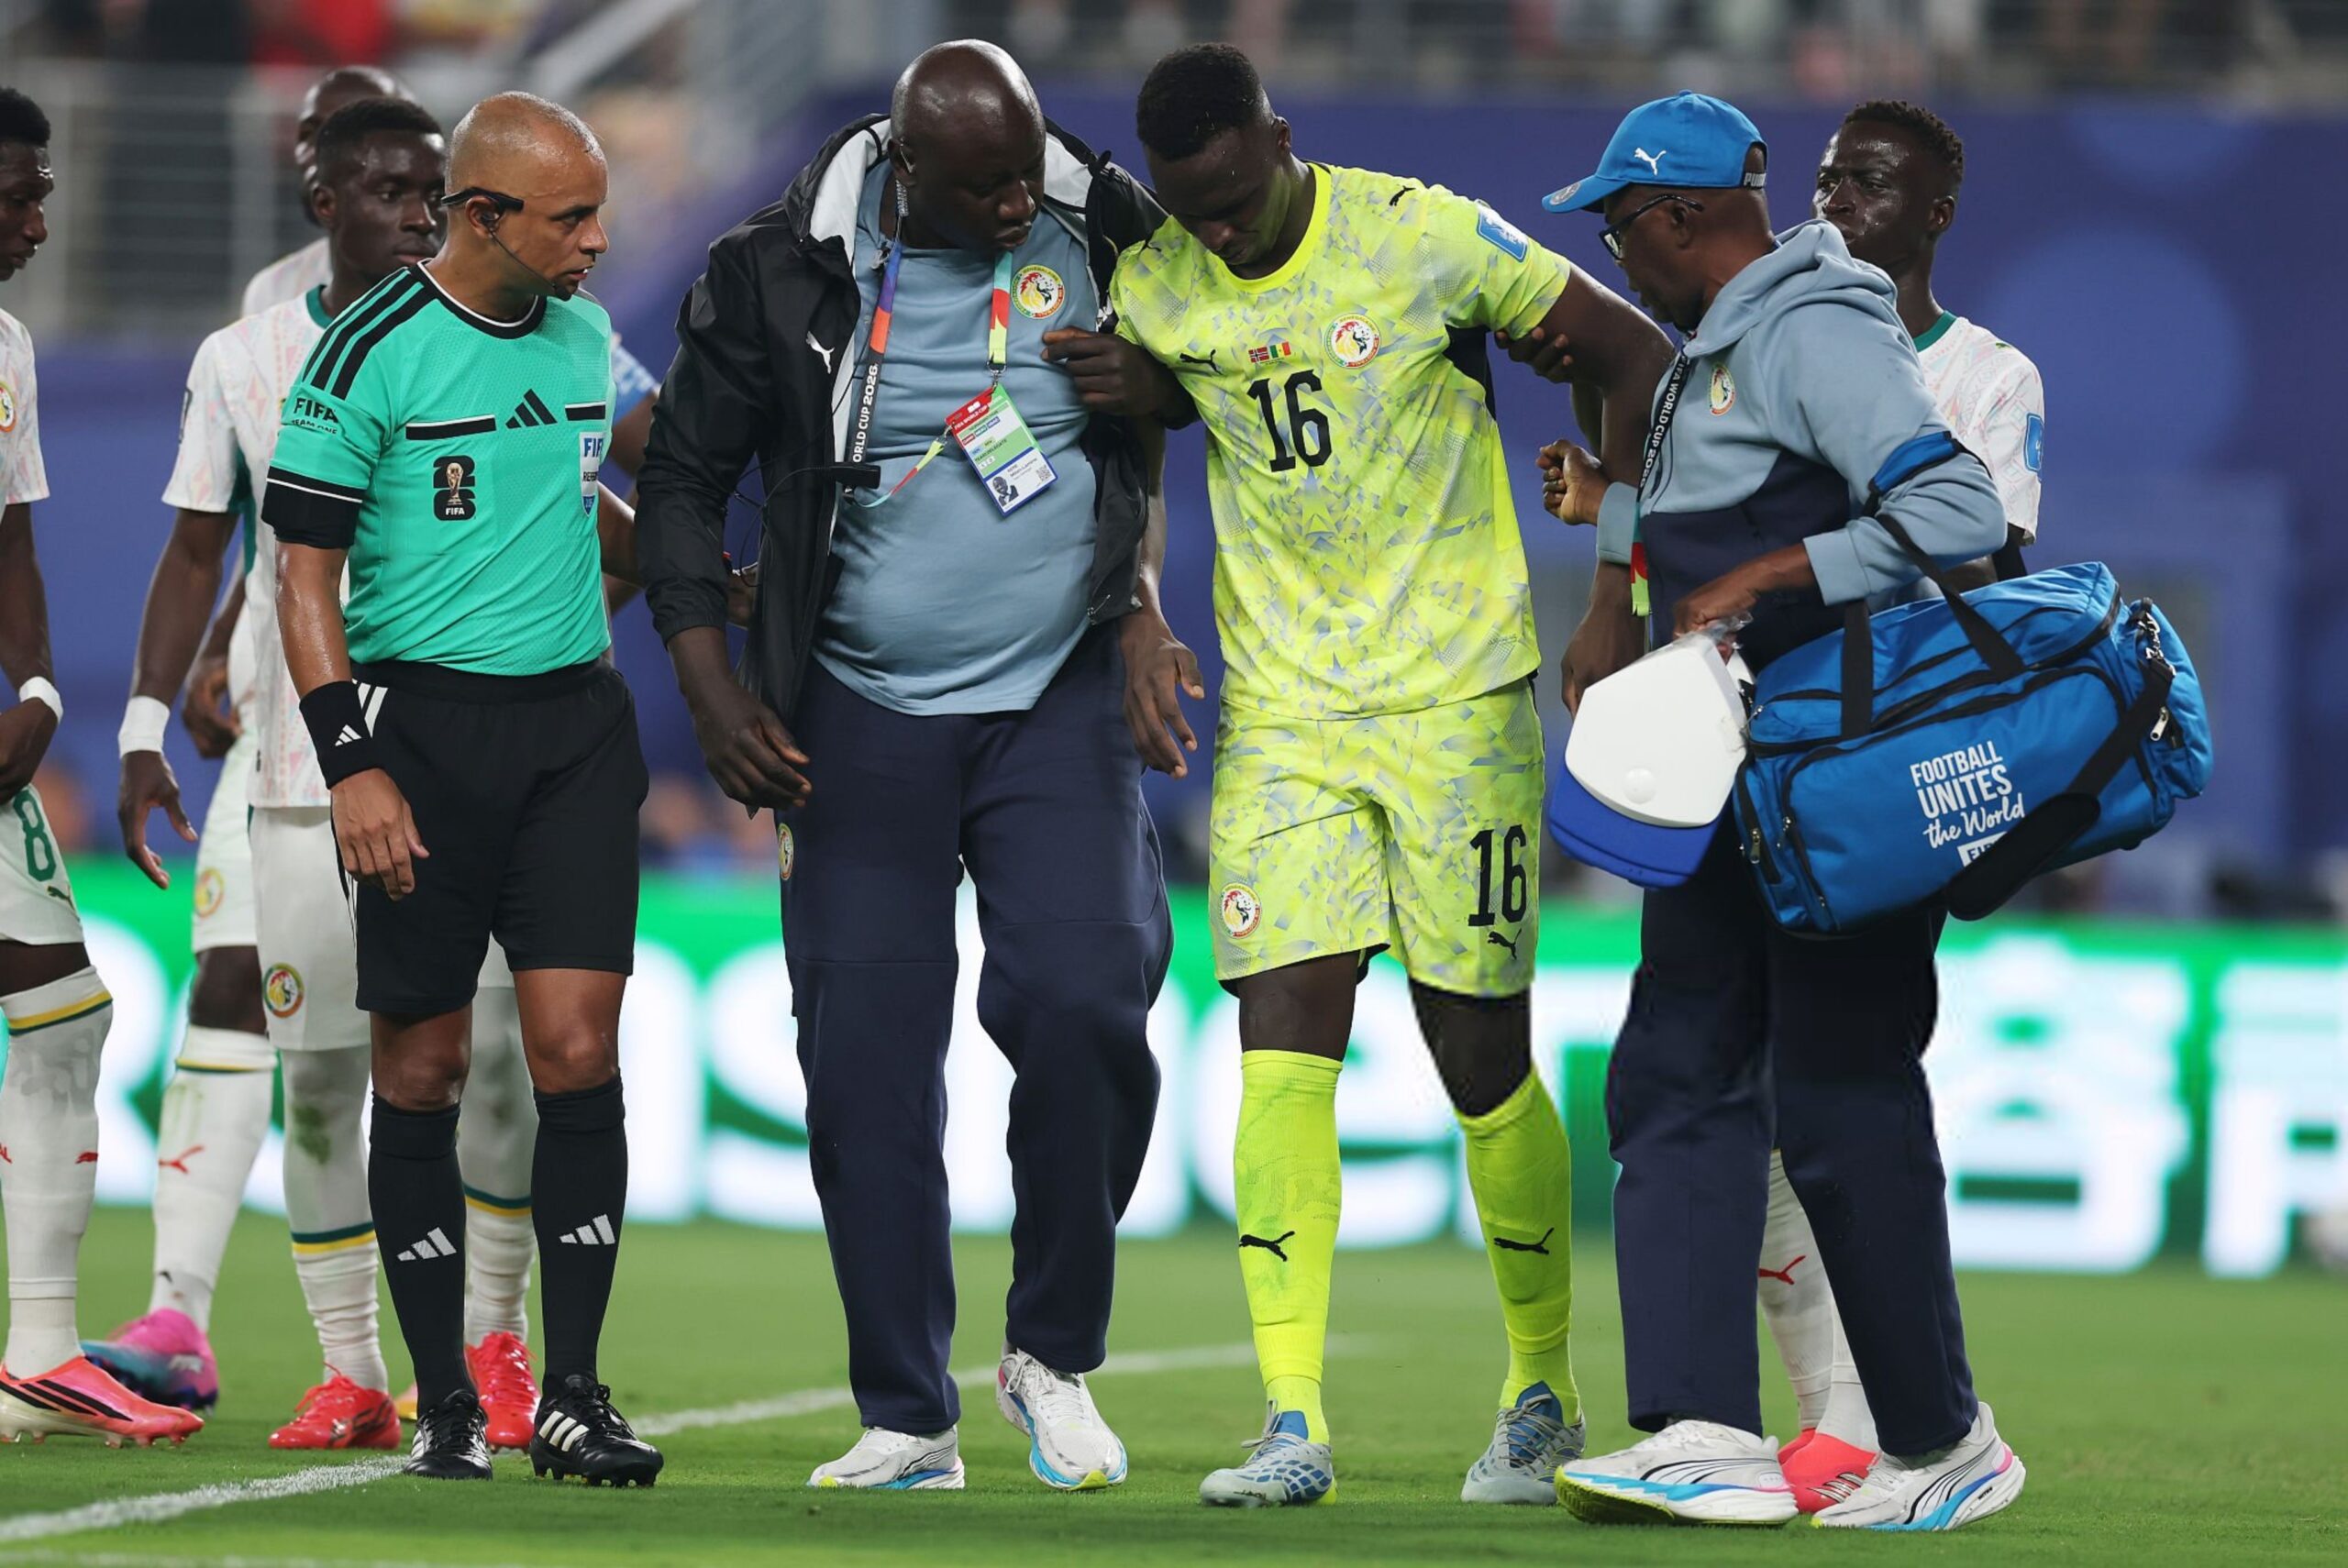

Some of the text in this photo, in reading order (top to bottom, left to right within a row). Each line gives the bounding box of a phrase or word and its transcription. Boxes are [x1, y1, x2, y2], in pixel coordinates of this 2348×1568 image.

[1744, 172, 1767, 186] PUM
[294, 397, 338, 424] FIFA
[852, 365, 879, 463] ORLD CUP 2026
[1246, 369, 1333, 472] 16
[1658, 382, 1679, 424] WORLD
[583, 438, 604, 458] FIF
[1651, 425, 1665, 447] CUP
[445, 507, 465, 515] FIFA
[1910, 740, 2003, 787] FOOTBALL
[1917, 764, 2012, 819] UNITES
[12, 789, 57, 882] 8
[1922, 792, 2026, 849] the World
[1468, 824, 1528, 928] 16
